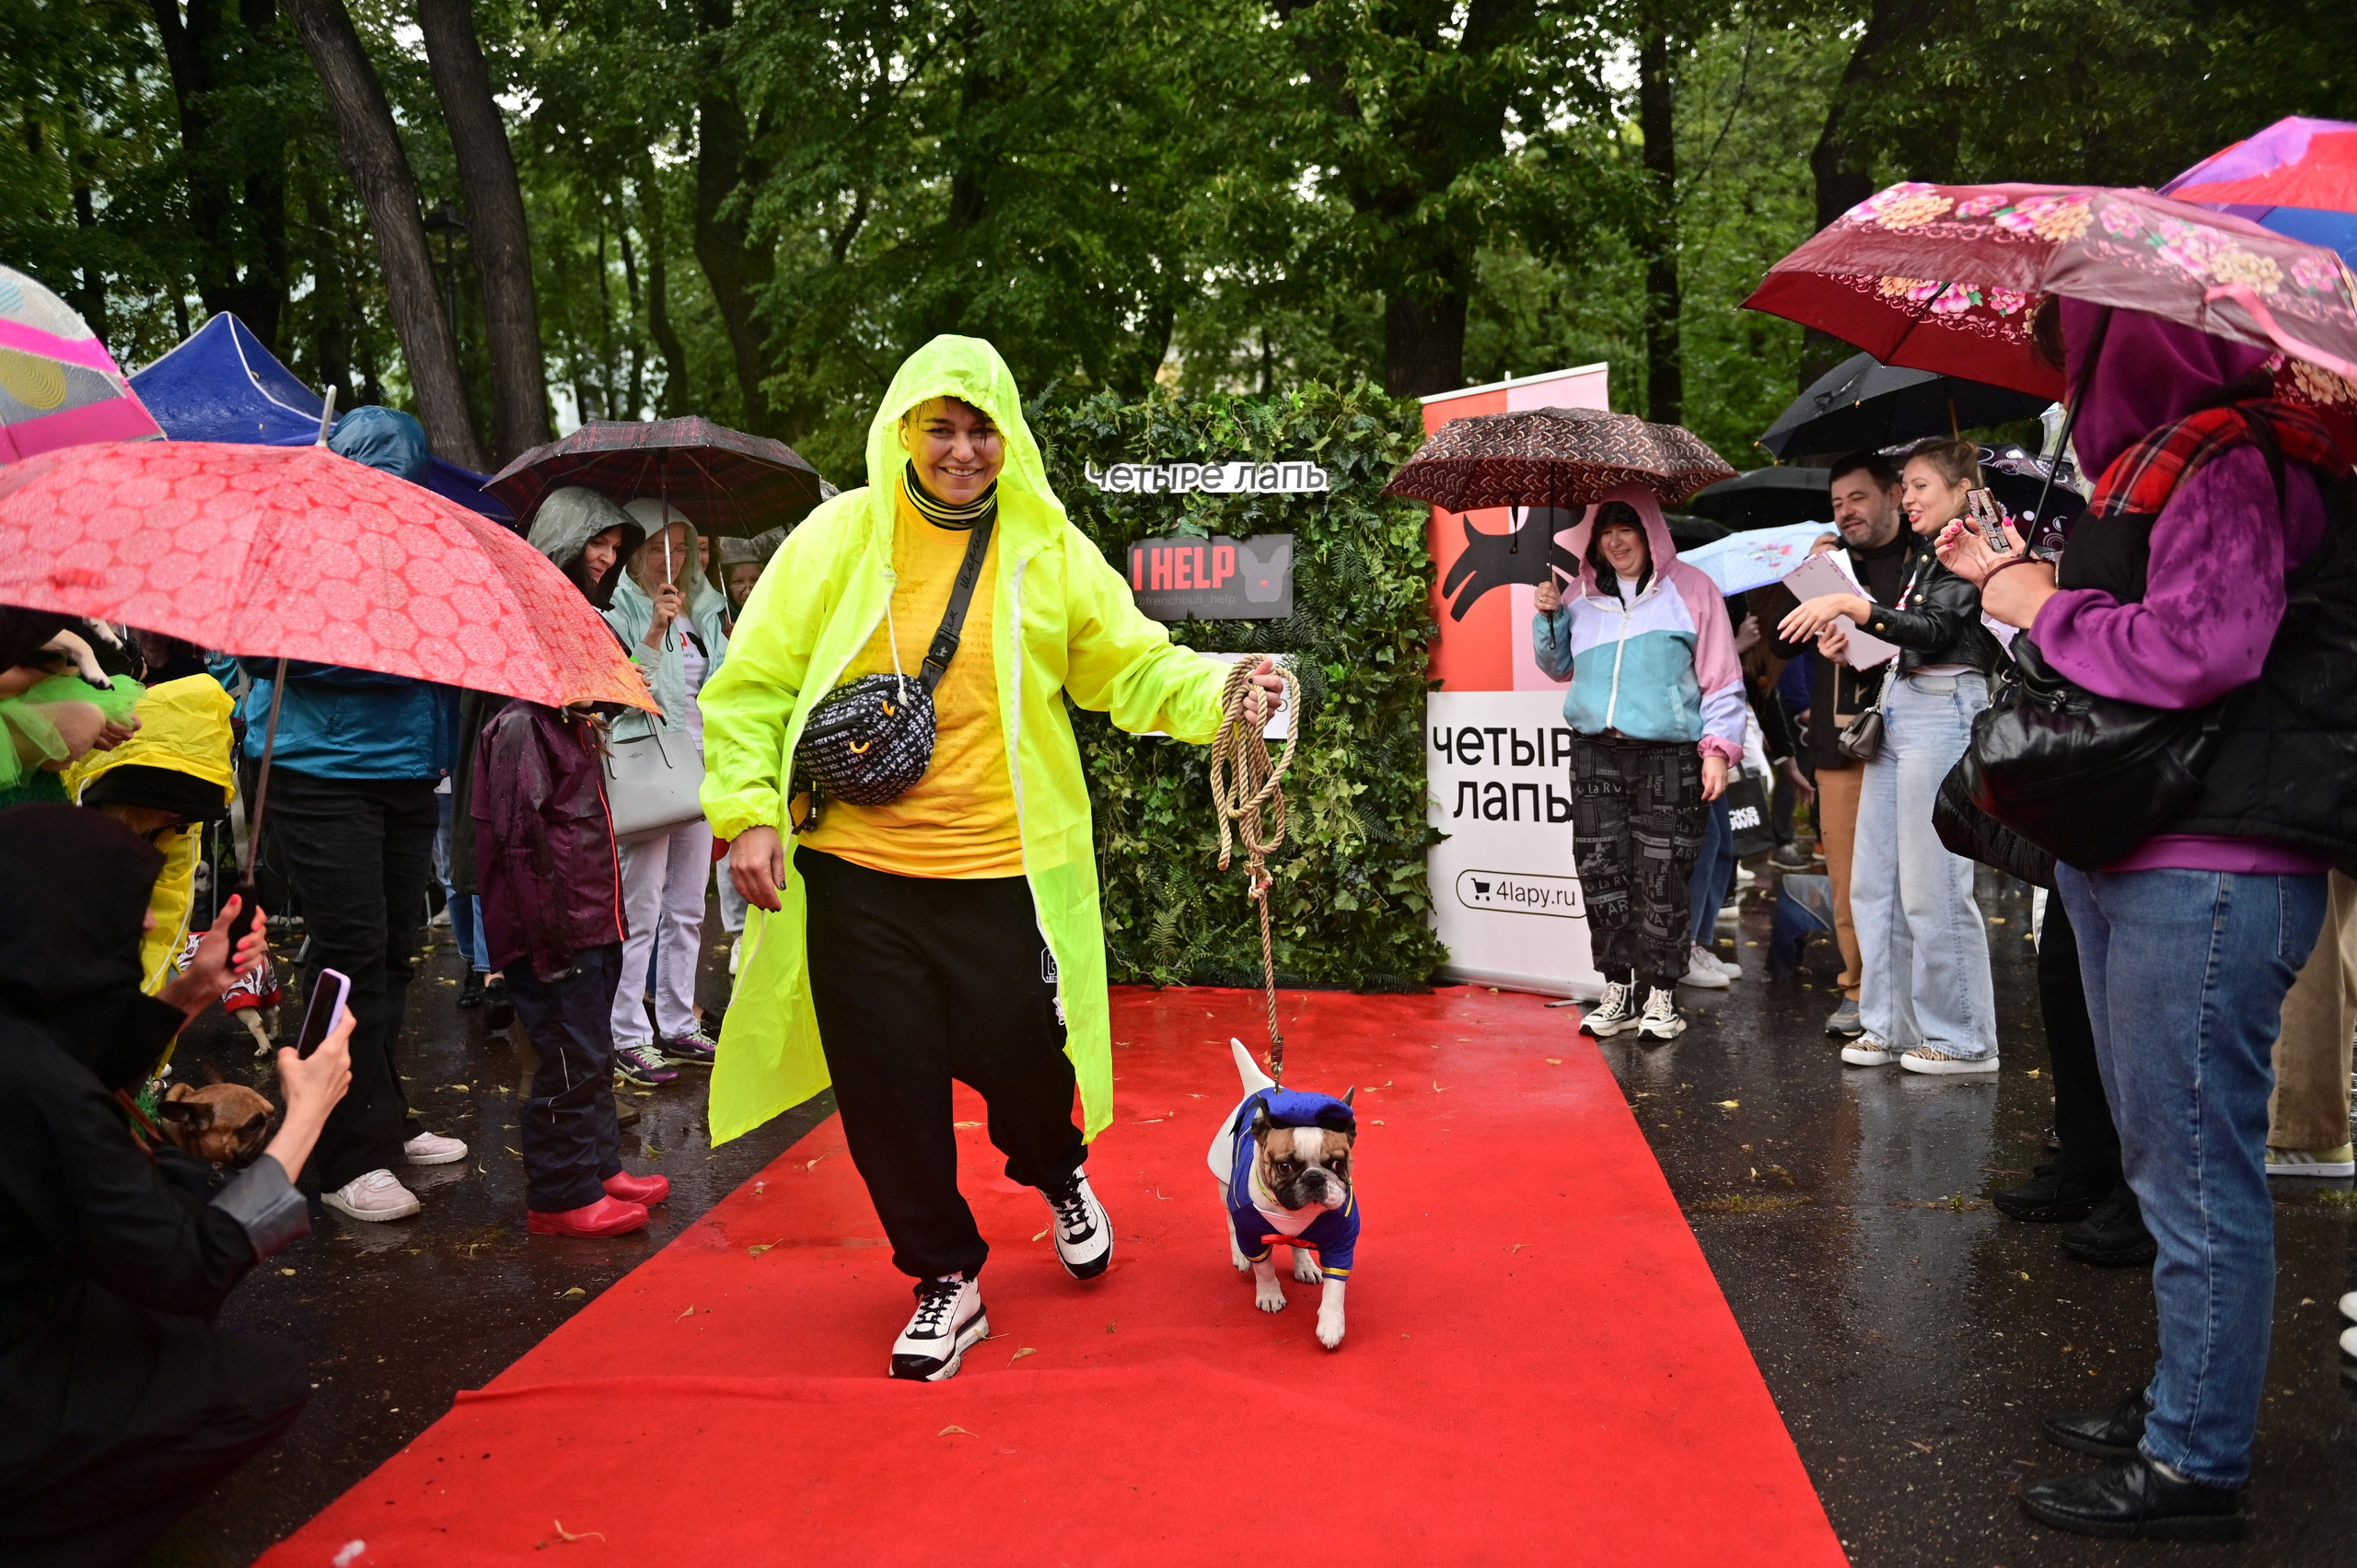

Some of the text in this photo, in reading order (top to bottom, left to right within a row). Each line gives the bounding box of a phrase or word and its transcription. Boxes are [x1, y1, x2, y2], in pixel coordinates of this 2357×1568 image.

[1133, 545, 1236, 591] I HELP
[1134, 594, 1236, 608] @frenchbull_help
[1433, 726, 1572, 767] четыр
[1588, 783, 1599, 795] La
[1496, 881, 1575, 908] 4lapy.ru
